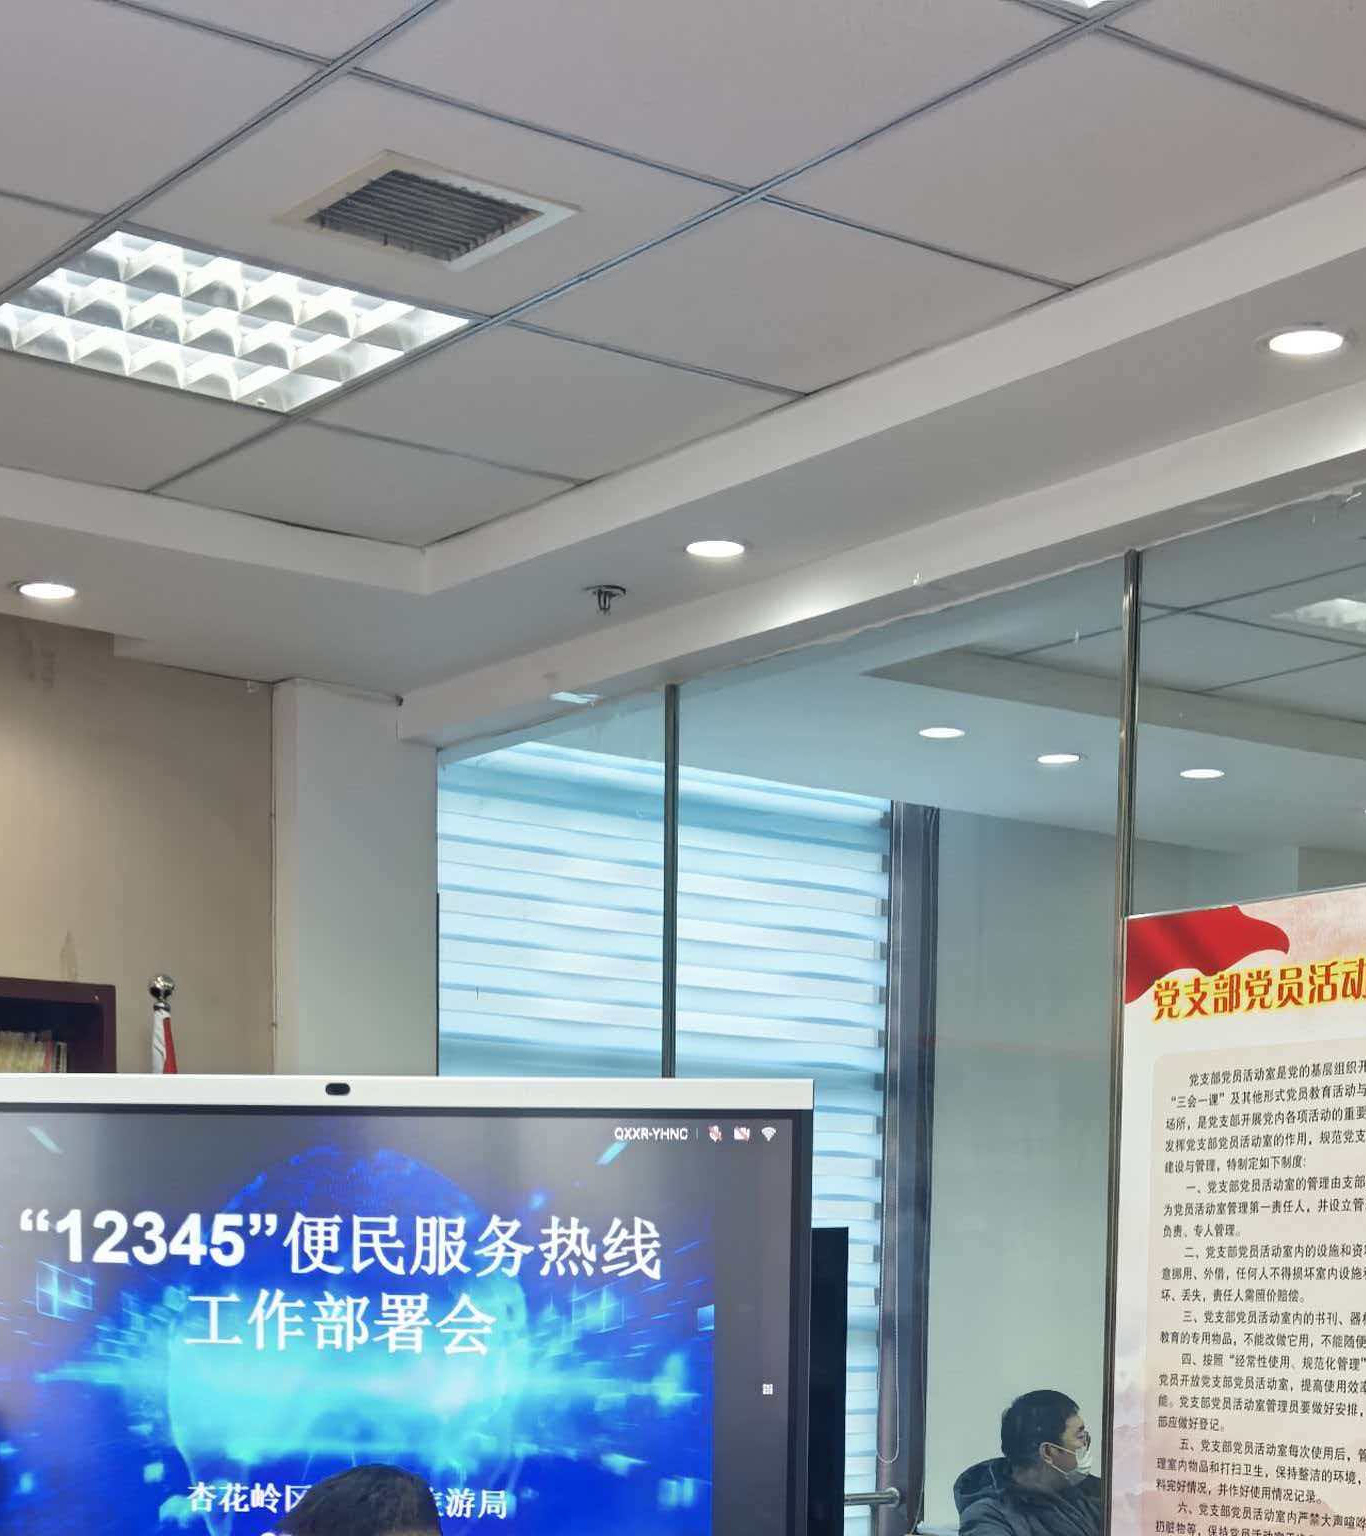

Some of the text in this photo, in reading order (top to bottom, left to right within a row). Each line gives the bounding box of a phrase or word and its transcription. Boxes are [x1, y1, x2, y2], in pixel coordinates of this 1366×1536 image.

[19, 1207, 663, 1281] “12345”便民服务热线
[184, 1290, 497, 1357] 工作部署会
